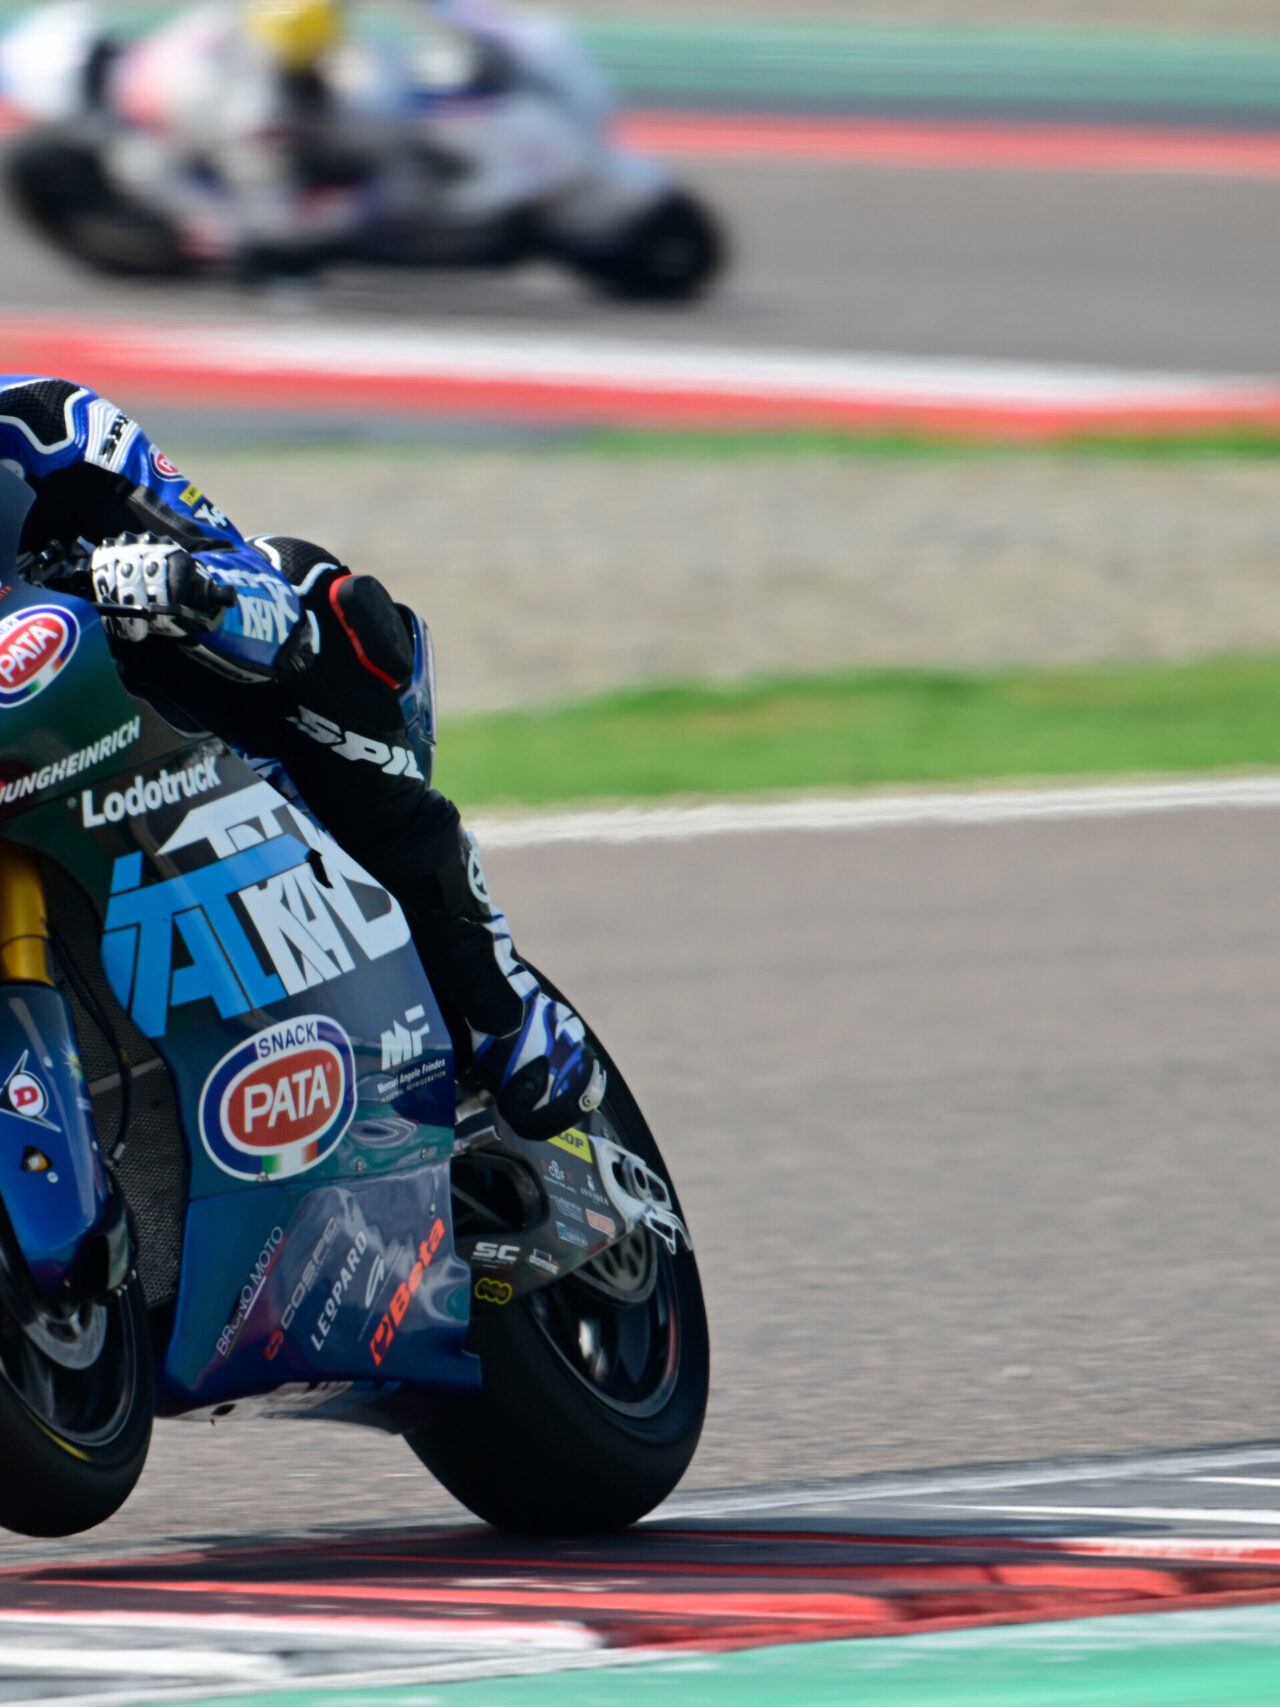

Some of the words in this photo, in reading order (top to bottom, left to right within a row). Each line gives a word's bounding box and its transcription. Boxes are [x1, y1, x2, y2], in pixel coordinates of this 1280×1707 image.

[81, 755, 221, 829] Lodotruck
[258, 1021, 318, 1058] SNACK
[13, 1085, 40, 1109] D
[244, 1064, 331, 1134] PATA
[250, 1226, 283, 1285] MOTO
[390, 1218, 445, 1328] Beta
[473, 1241, 520, 1261] SC
[310, 1231, 367, 1351] LEOPARD
